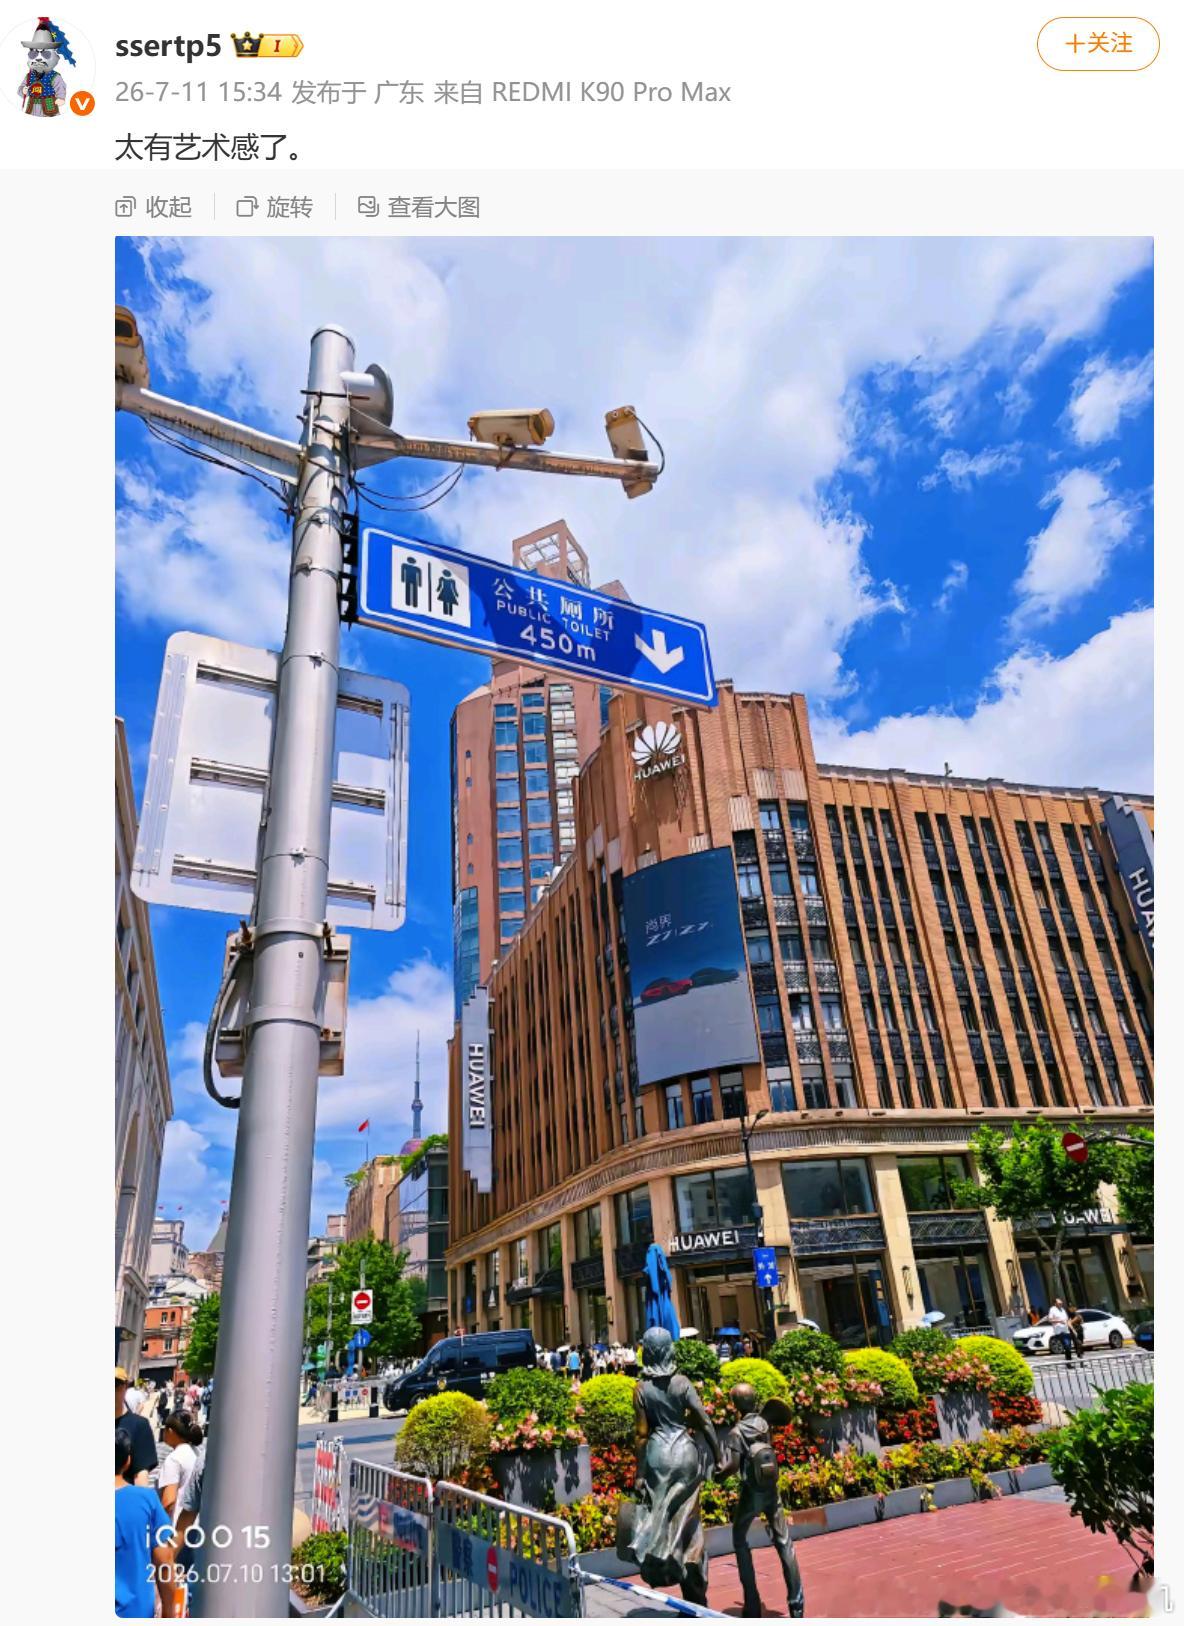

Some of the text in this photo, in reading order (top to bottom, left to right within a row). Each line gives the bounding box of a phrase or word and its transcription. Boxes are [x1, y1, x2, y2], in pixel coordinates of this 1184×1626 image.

[492, 577, 615, 631] 公共厕所
[497, 600, 611, 642] PUBLIC TOILET
[520, 624, 596, 662] 450m
[633, 754, 686, 781] HUAWEI
[1129, 867, 1154, 948] HUA
[468, 1043, 485, 1126] HUAWEI
[668, 1230, 740, 1252] HUAWEI
[509, 1561, 563, 1618] POLICE
